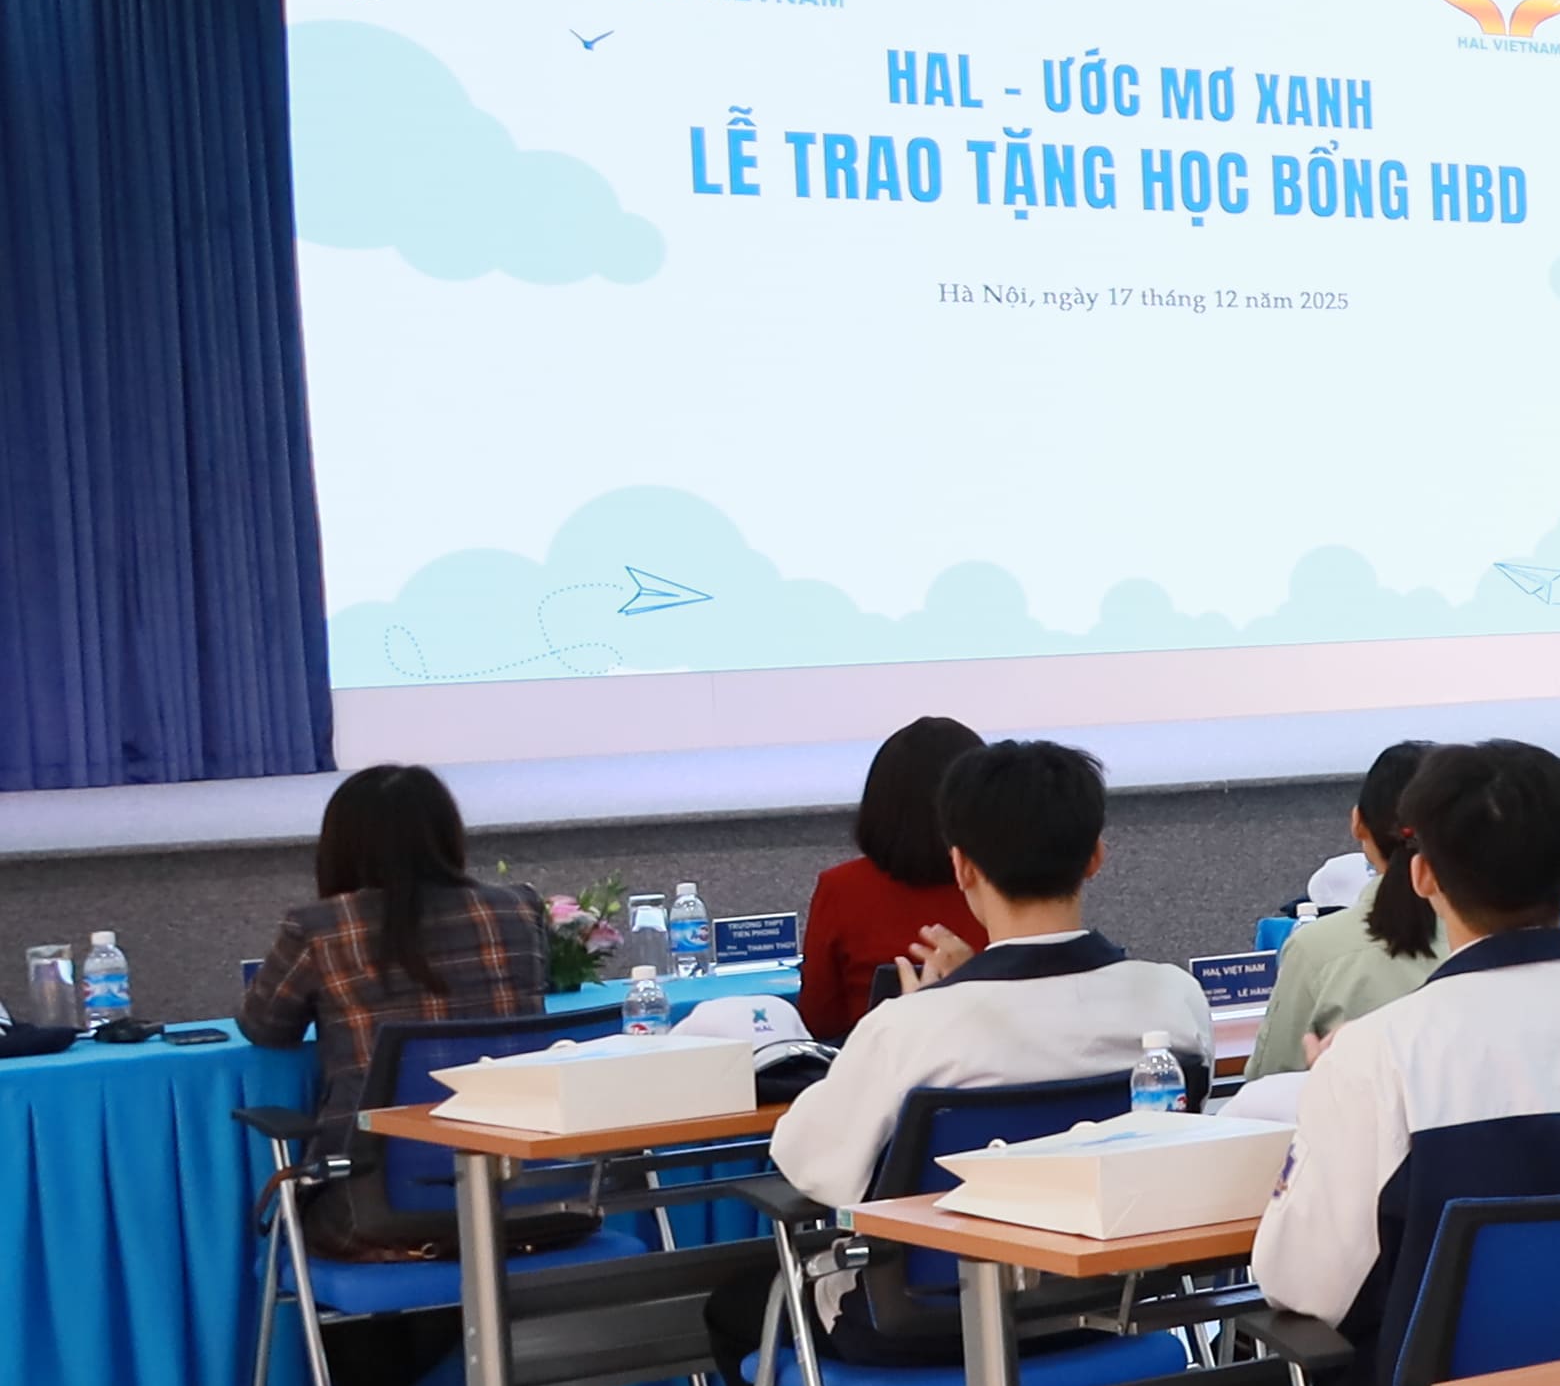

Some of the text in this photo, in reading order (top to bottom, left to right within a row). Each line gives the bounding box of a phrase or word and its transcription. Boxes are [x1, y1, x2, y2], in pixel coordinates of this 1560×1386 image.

[1457, 36, 1488, 50] HAL
[887, 49, 984, 109] HAL
[1043, 47, 1141, 116] ƯỚC
[1160, 66, 1236, 122] MƠ
[1255, 72, 1374, 130] XANH
[690, 105, 1528, 227] LỄ TRAO TẶNG HỌC BỔNG HBD
[938, 283, 1349, 314] Hà Nội, ngày 17 tháng 12 năm 2025
